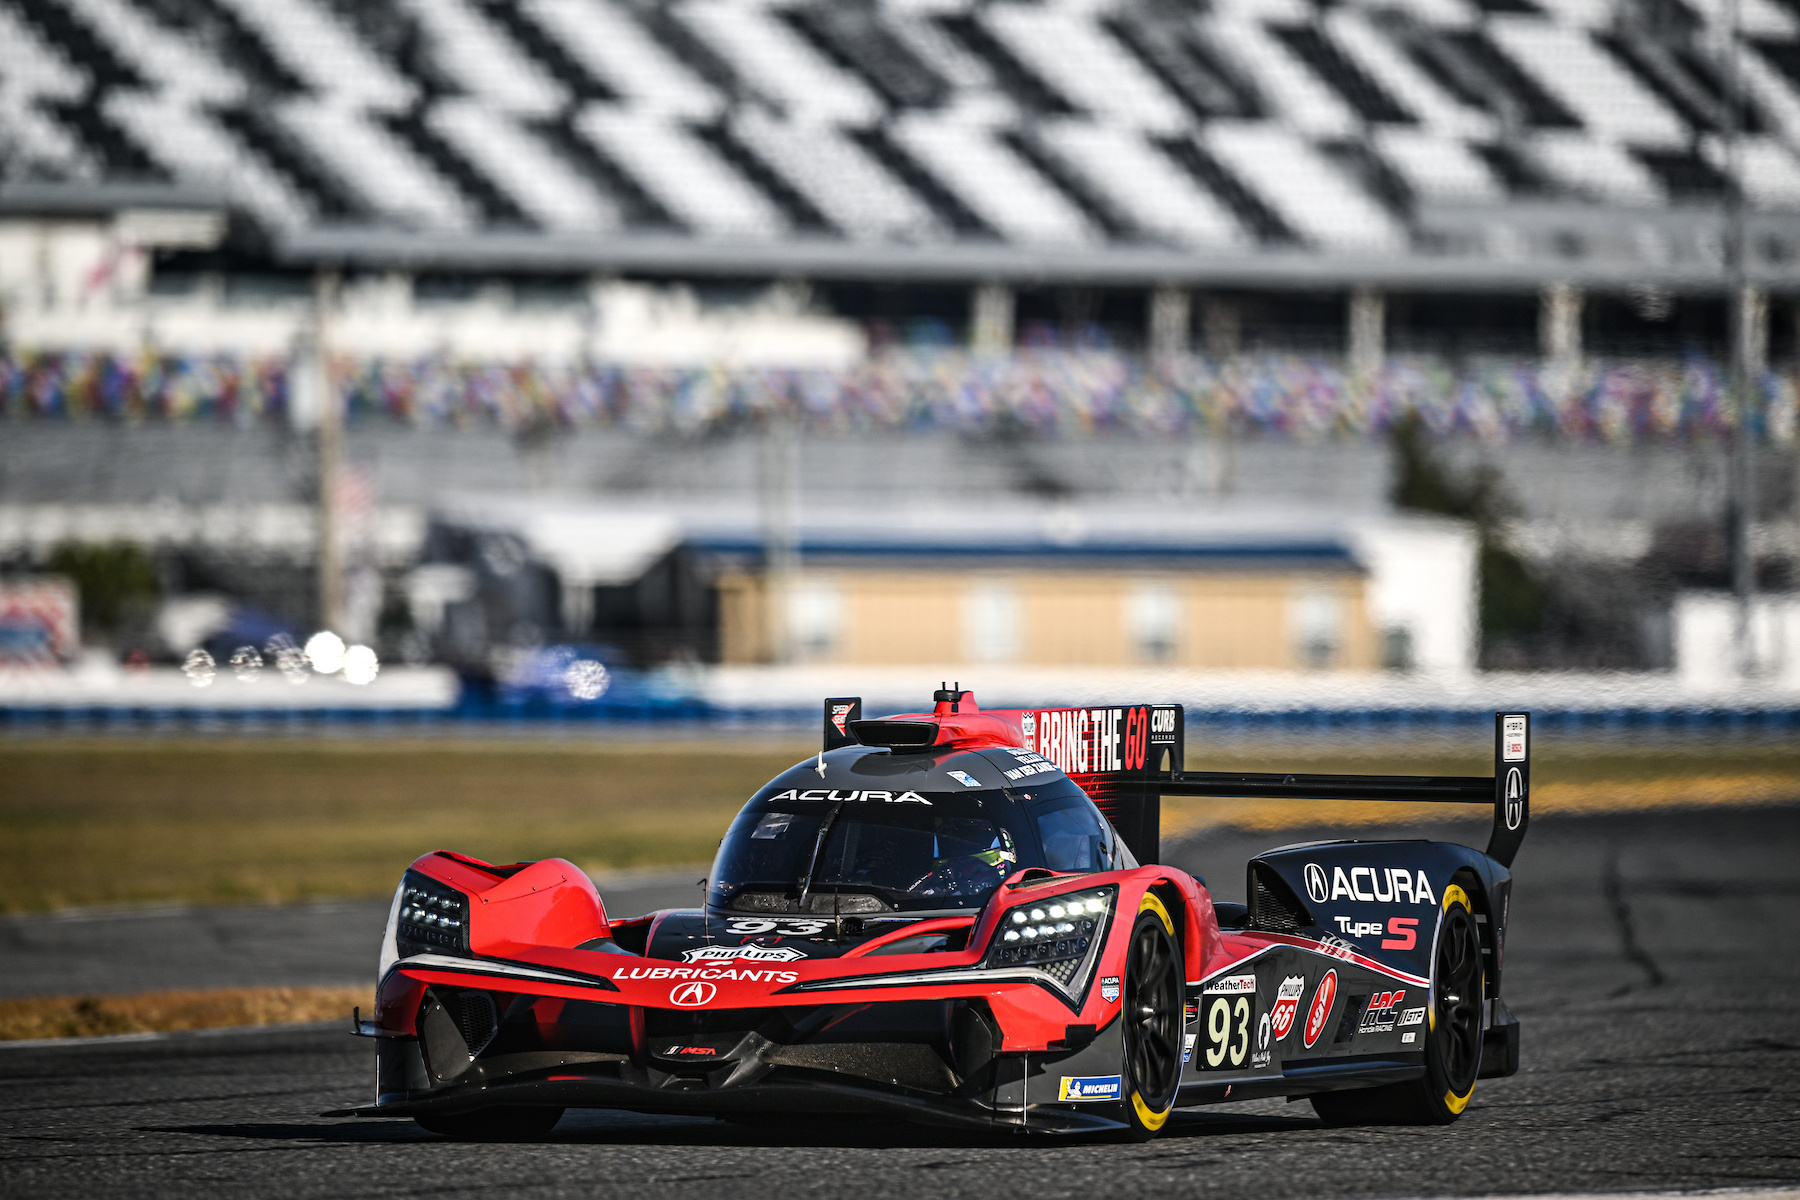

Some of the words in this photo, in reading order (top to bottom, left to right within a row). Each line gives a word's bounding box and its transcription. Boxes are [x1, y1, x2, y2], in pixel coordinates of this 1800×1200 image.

[1151, 710, 1175, 733] CURB
[1040, 709, 1089, 774] BRING
[1091, 709, 1122, 772] THE
[1125, 707, 1147, 771] GO
[1003, 767, 1025, 781] VAN
[1018, 763, 1039, 777] DER
[768, 789, 933, 806] ACURA
[1331, 866, 1437, 905] ACURA
[726, 921, 828, 936] 93
[1333, 915, 1383, 938] Type
[1381, 916, 1420, 951] S
[701, 950, 788, 960] PHILLIPS
[612, 967, 799, 983] LUBRICANTS
[1104, 977, 1119, 985] ACURA
[1206, 979, 1255, 991] WeatherTech
[1280, 983, 1303, 997] PHILLIPS
[1271, 1004, 1294, 1031] 66
[1406, 1010, 1424, 1022] GTP
[1206, 996, 1250, 1067] 93
[1375, 1024, 1394, 1033] RACING
[679, 1046, 717, 1056] IMSA
[1082, 1083, 1119, 1095] MICHELIN
